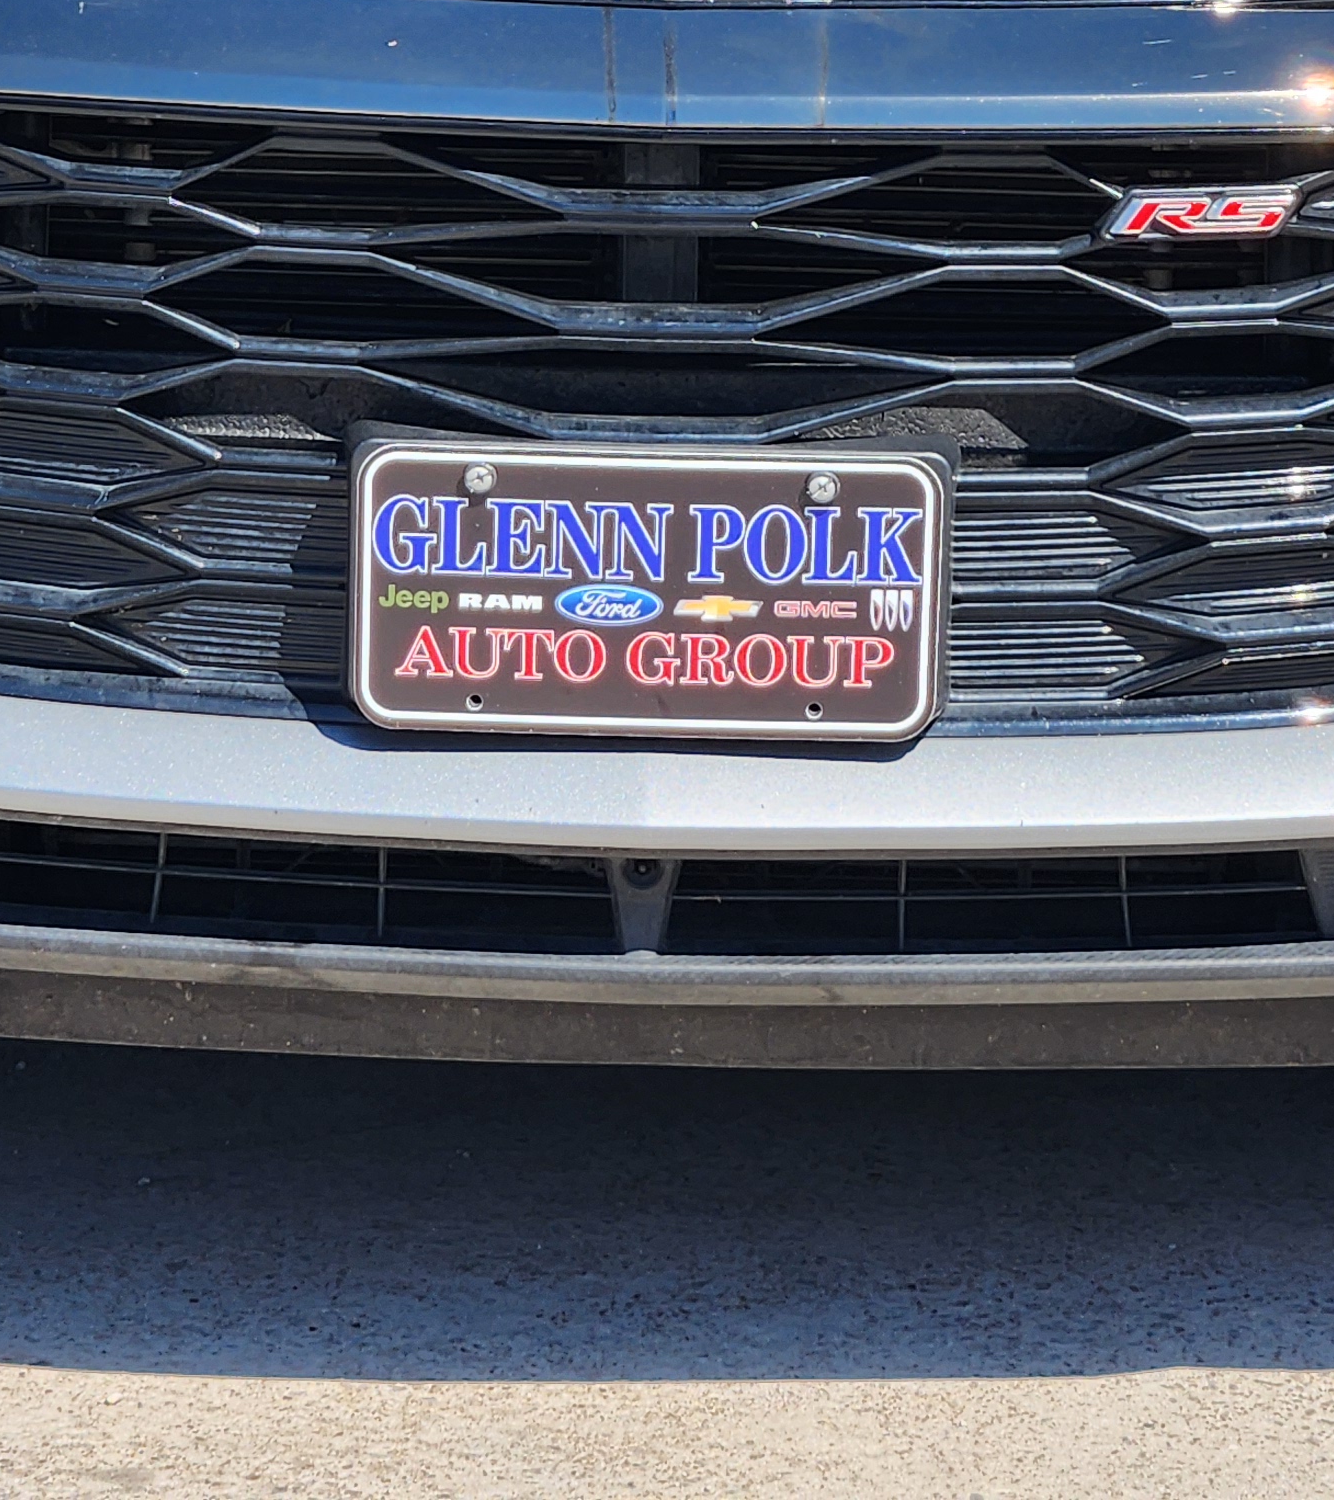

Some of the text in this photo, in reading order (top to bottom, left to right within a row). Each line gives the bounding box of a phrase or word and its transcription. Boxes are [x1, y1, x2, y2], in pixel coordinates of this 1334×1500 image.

[1109, 196, 1293, 235] RS
[372, 493, 924, 586] GLENN POLK
[379, 583, 857, 620] Jeep RAM Ford GMC
[395, 625, 895, 688] AUTO GROUP
